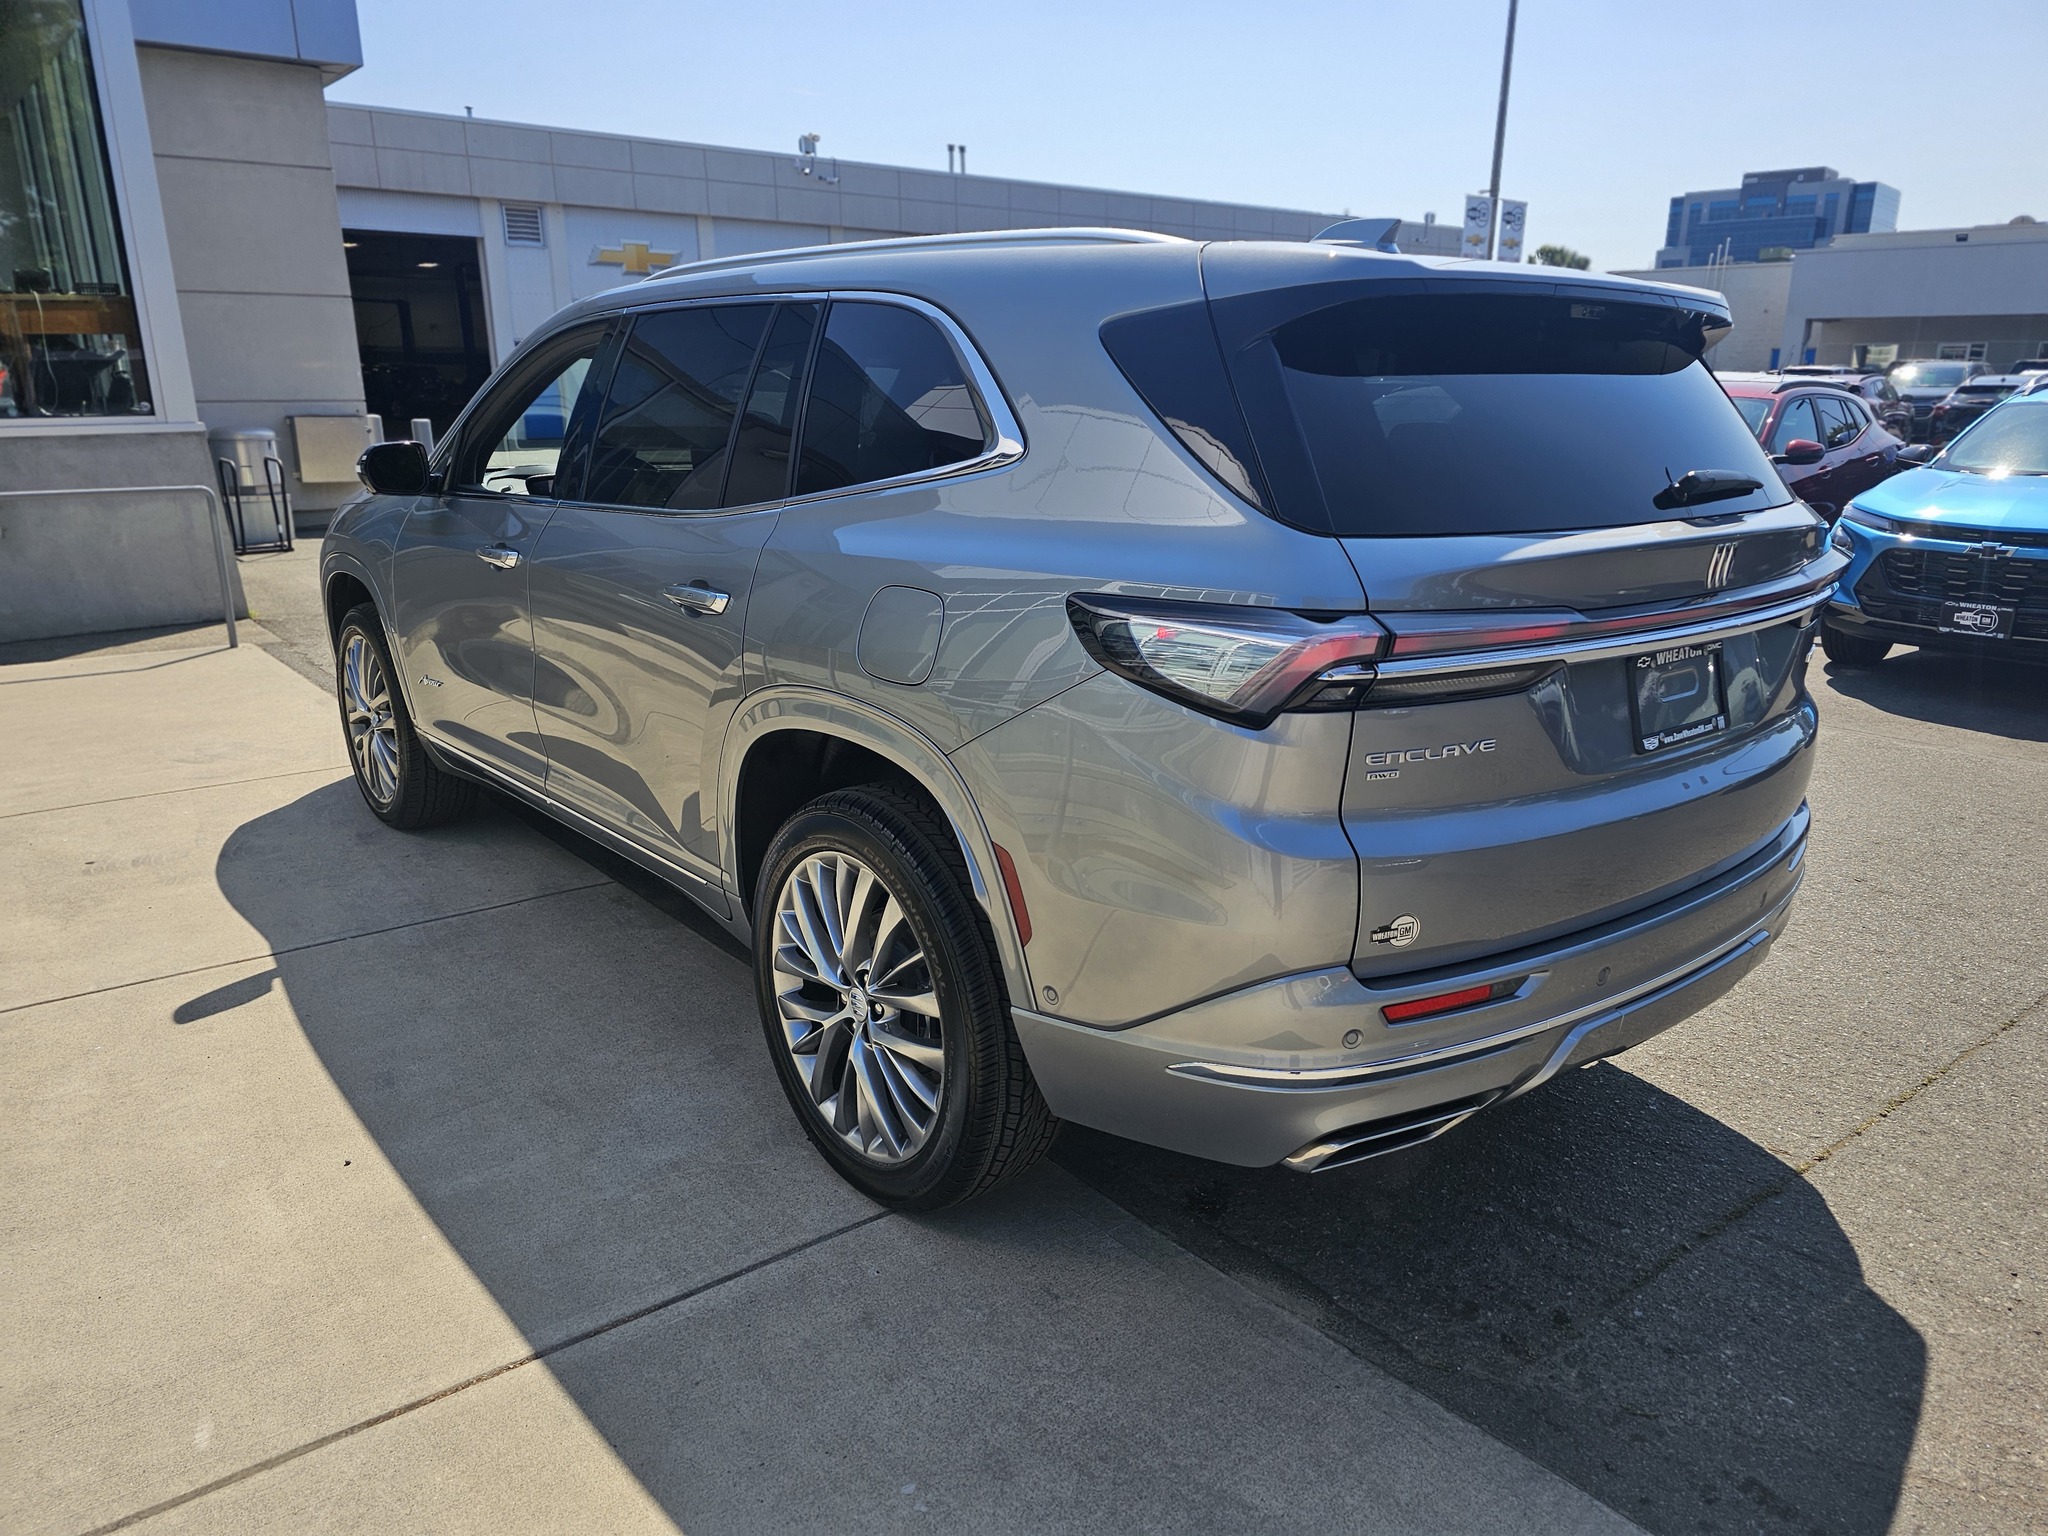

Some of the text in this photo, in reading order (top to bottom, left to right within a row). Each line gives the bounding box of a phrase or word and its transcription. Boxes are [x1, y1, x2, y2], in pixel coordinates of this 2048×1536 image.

[1959, 601, 1998, 611] WHEATON
[1955, 614, 1979, 623] WHEATON
[1656, 646, 1703, 666] WHEATON
[1365, 739, 1496, 766] ENCLAVE
[1368, 771, 1398, 780] AWD
[1372, 925, 1412, 942] WHEATON GM
